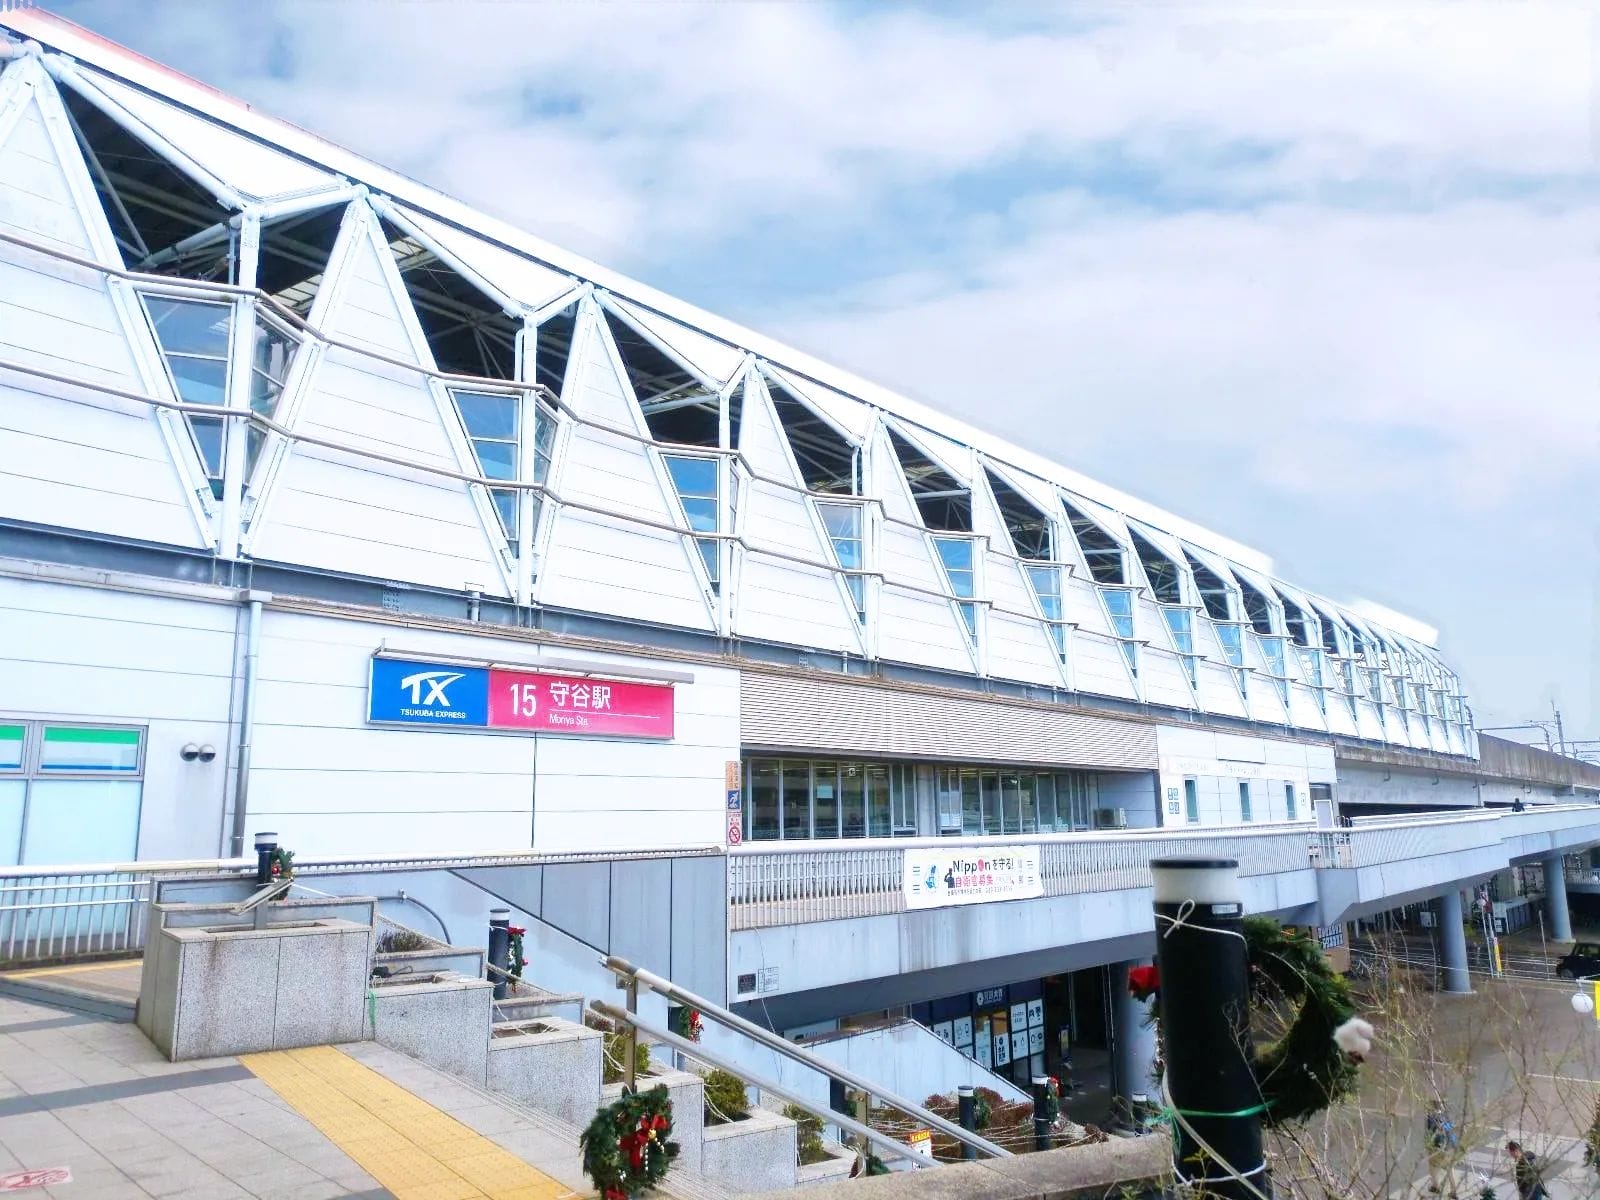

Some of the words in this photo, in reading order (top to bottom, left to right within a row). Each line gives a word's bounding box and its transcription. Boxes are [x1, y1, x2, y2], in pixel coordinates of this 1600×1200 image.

[401, 671, 466, 707] TX
[510, 683, 537, 717] 15
[549, 681, 611, 710] 守谷駅
[400, 708, 433, 717] TSUKUBA
[435, 710, 466, 719] EXPRESS
[549, 713, 574, 726] Moriya
